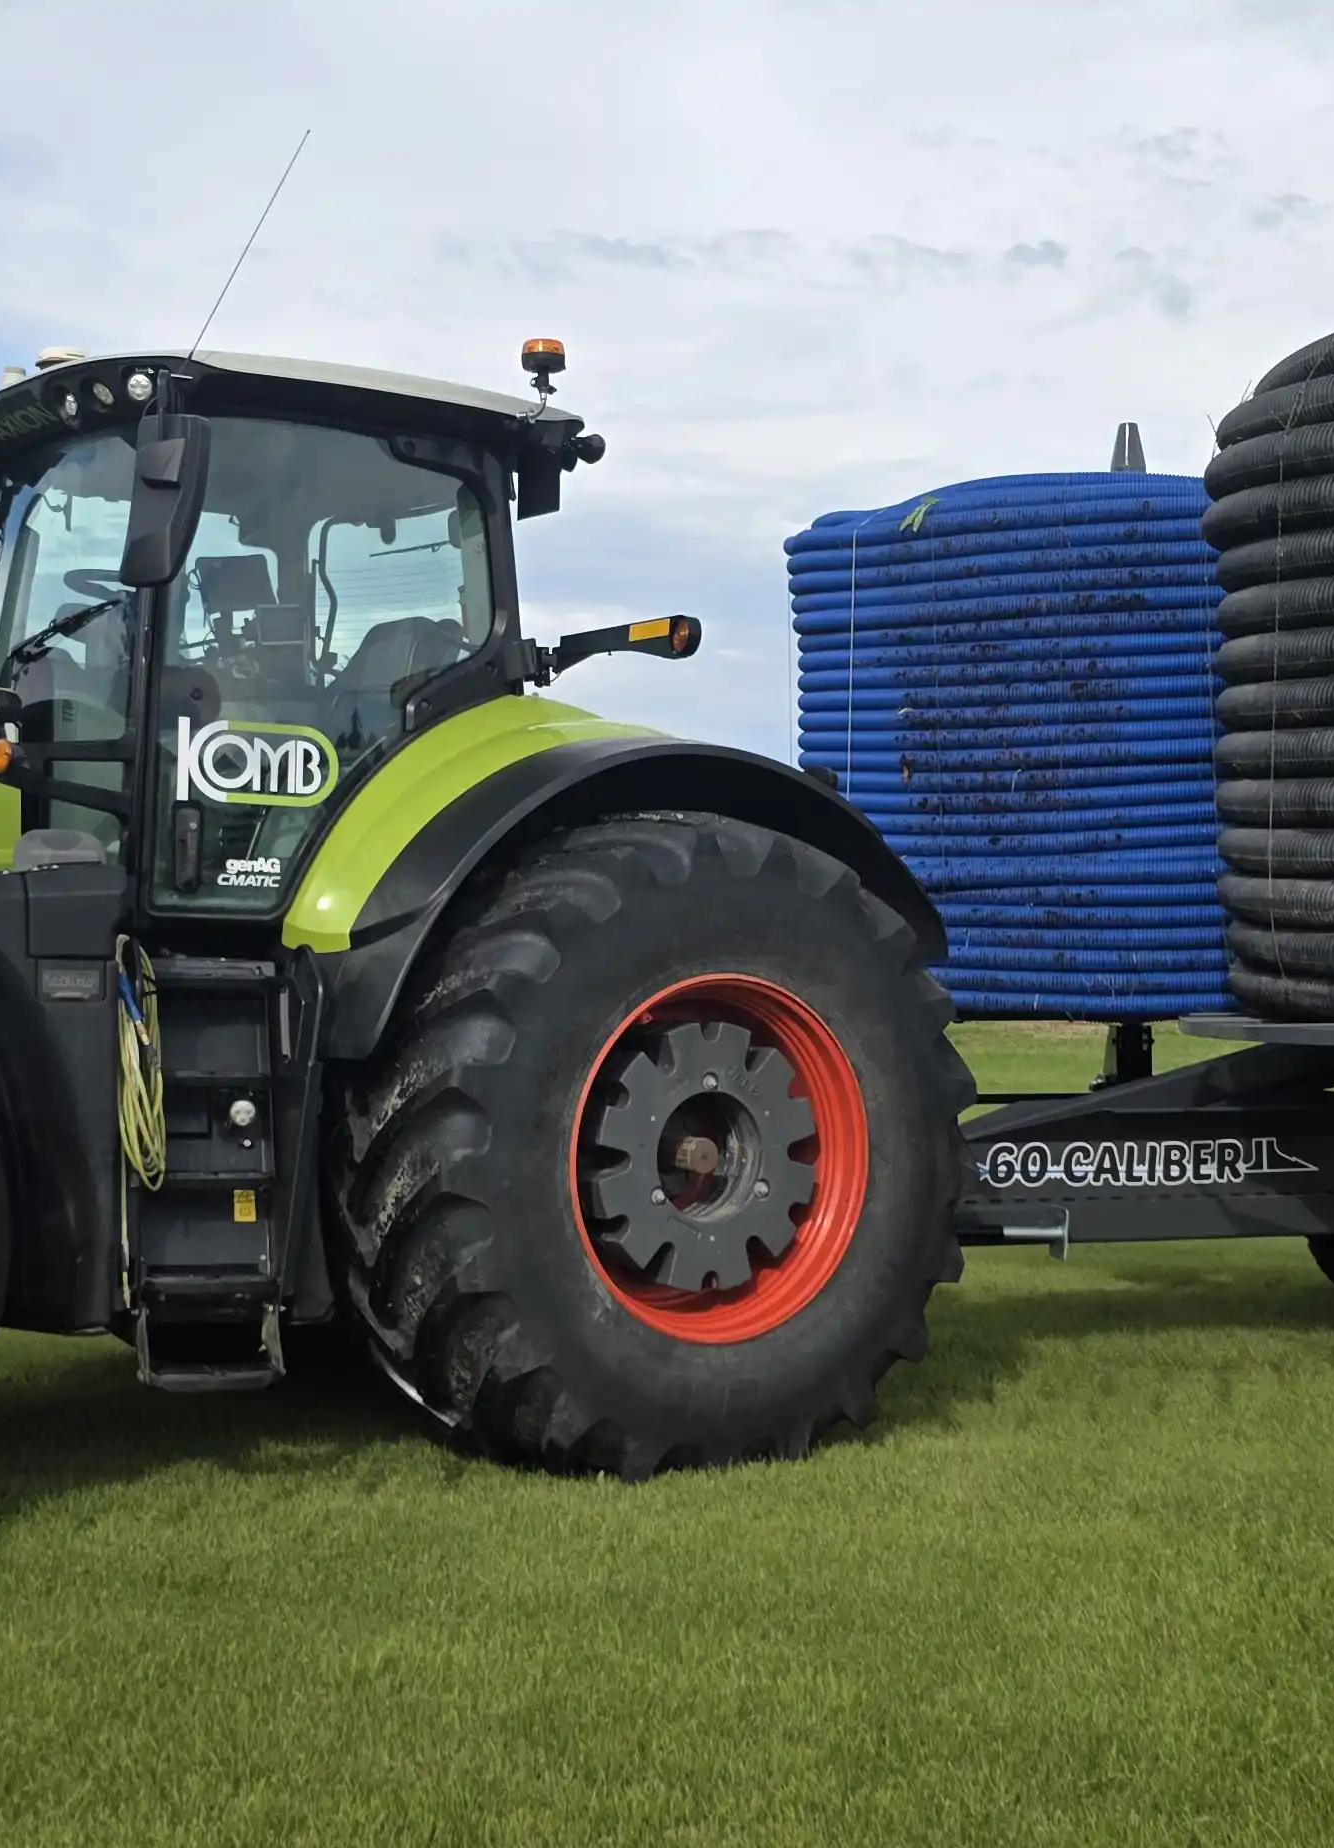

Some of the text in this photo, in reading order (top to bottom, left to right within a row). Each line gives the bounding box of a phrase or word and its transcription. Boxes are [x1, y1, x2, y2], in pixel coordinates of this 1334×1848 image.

[225, 857, 281, 875] genAG
[217, 873, 282, 888] CMATIC
[986, 1138, 1244, 1188] 60 CALIBER
